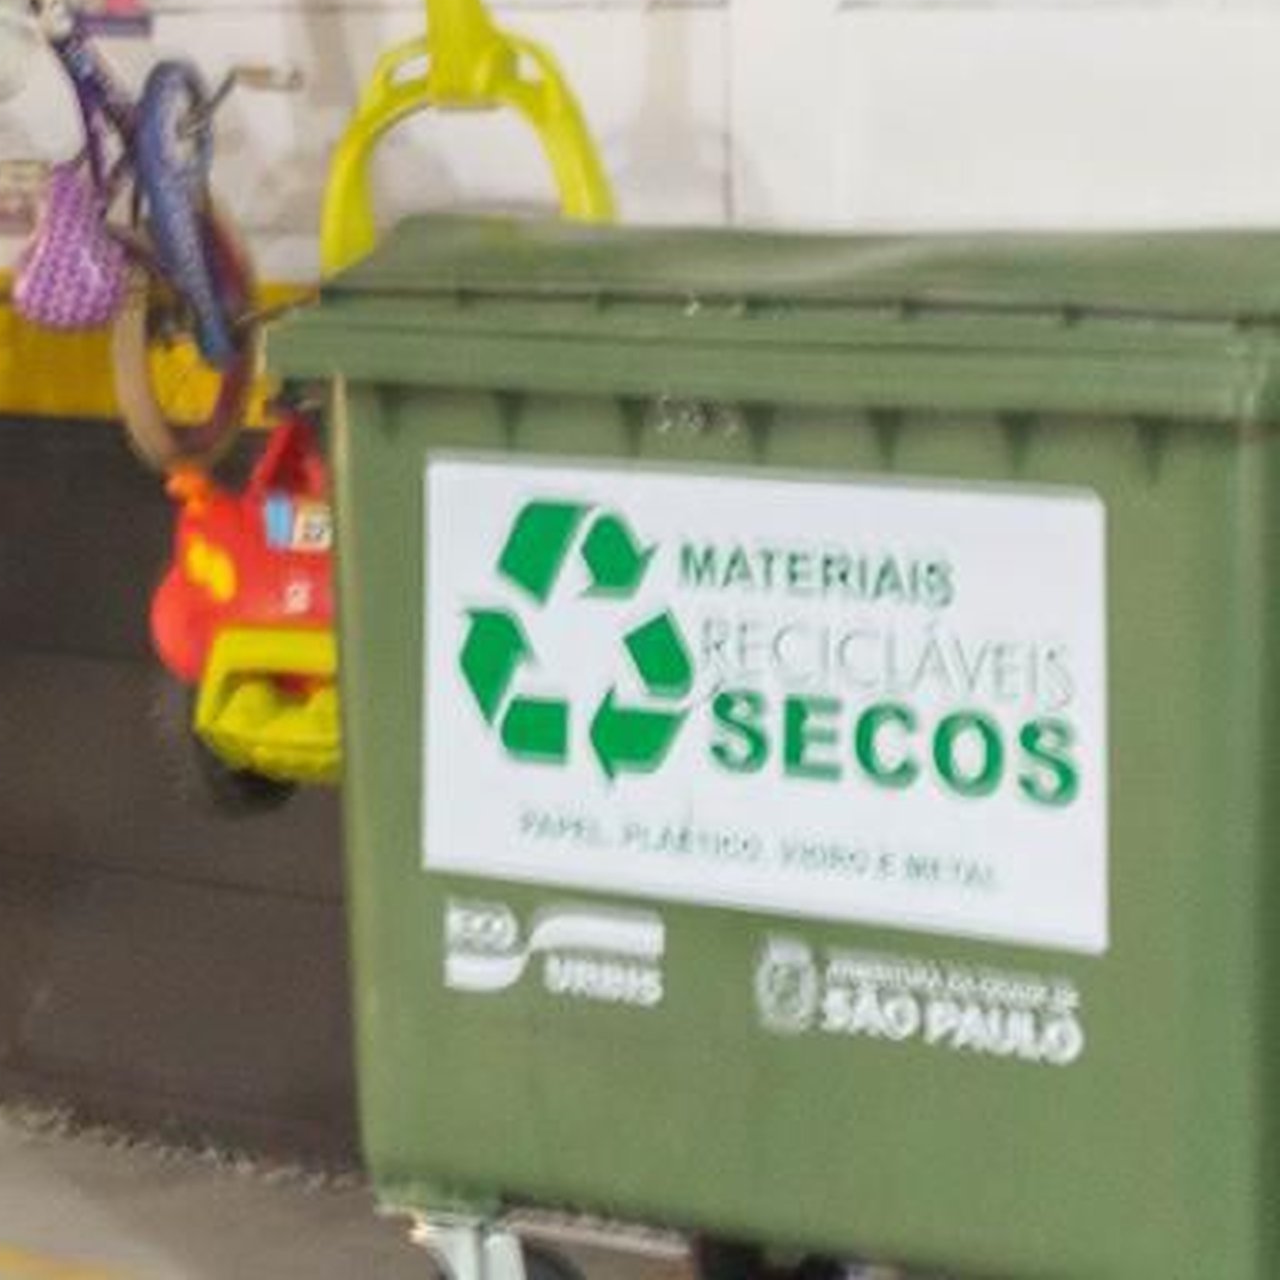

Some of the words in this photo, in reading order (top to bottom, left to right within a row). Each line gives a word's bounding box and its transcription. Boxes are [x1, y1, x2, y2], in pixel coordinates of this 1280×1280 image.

[677, 541, 955, 609] MATERIAIS
[700, 613, 1074, 710] RECICLÁVEIS
[709, 687, 1081, 808] SECOS
[924, 998, 1084, 1066] PAULO
